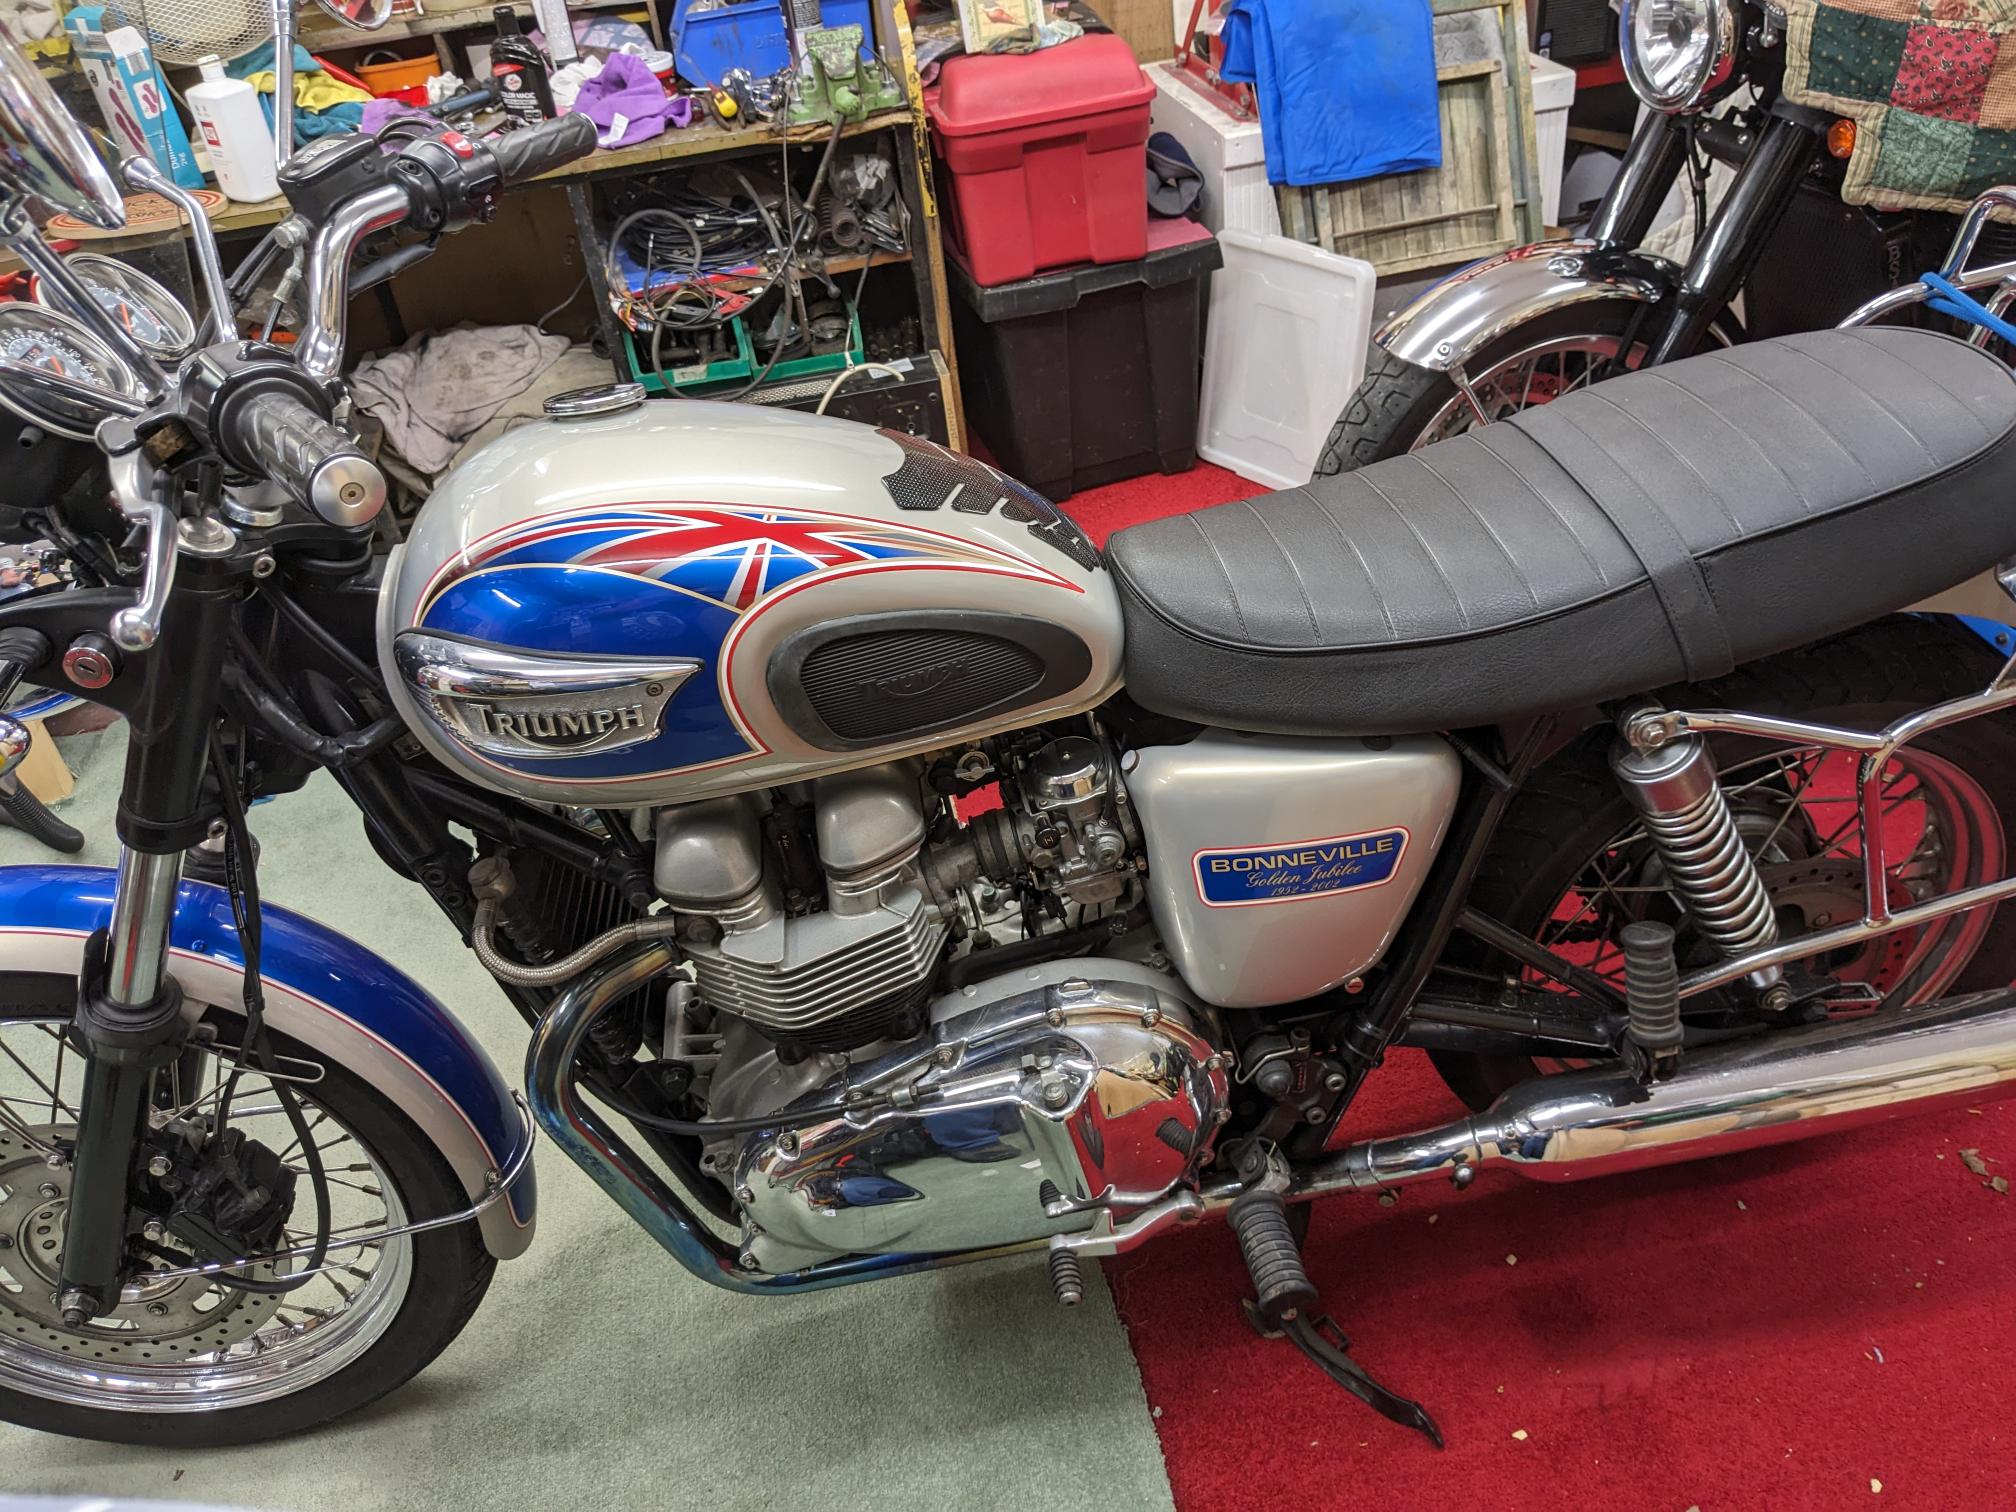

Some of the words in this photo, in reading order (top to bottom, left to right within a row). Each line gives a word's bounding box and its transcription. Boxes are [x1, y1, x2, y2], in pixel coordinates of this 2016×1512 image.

[857, 658, 970, 700] TRIUMPH
[466, 703, 645, 747] TRIUMPH
[1211, 837, 1394, 873] BONNEVILLE
[1246, 870, 1302, 888] Golden
[1302, 860, 1363, 885] Jubilee
[1311, 879, 1340, 893] 2002
